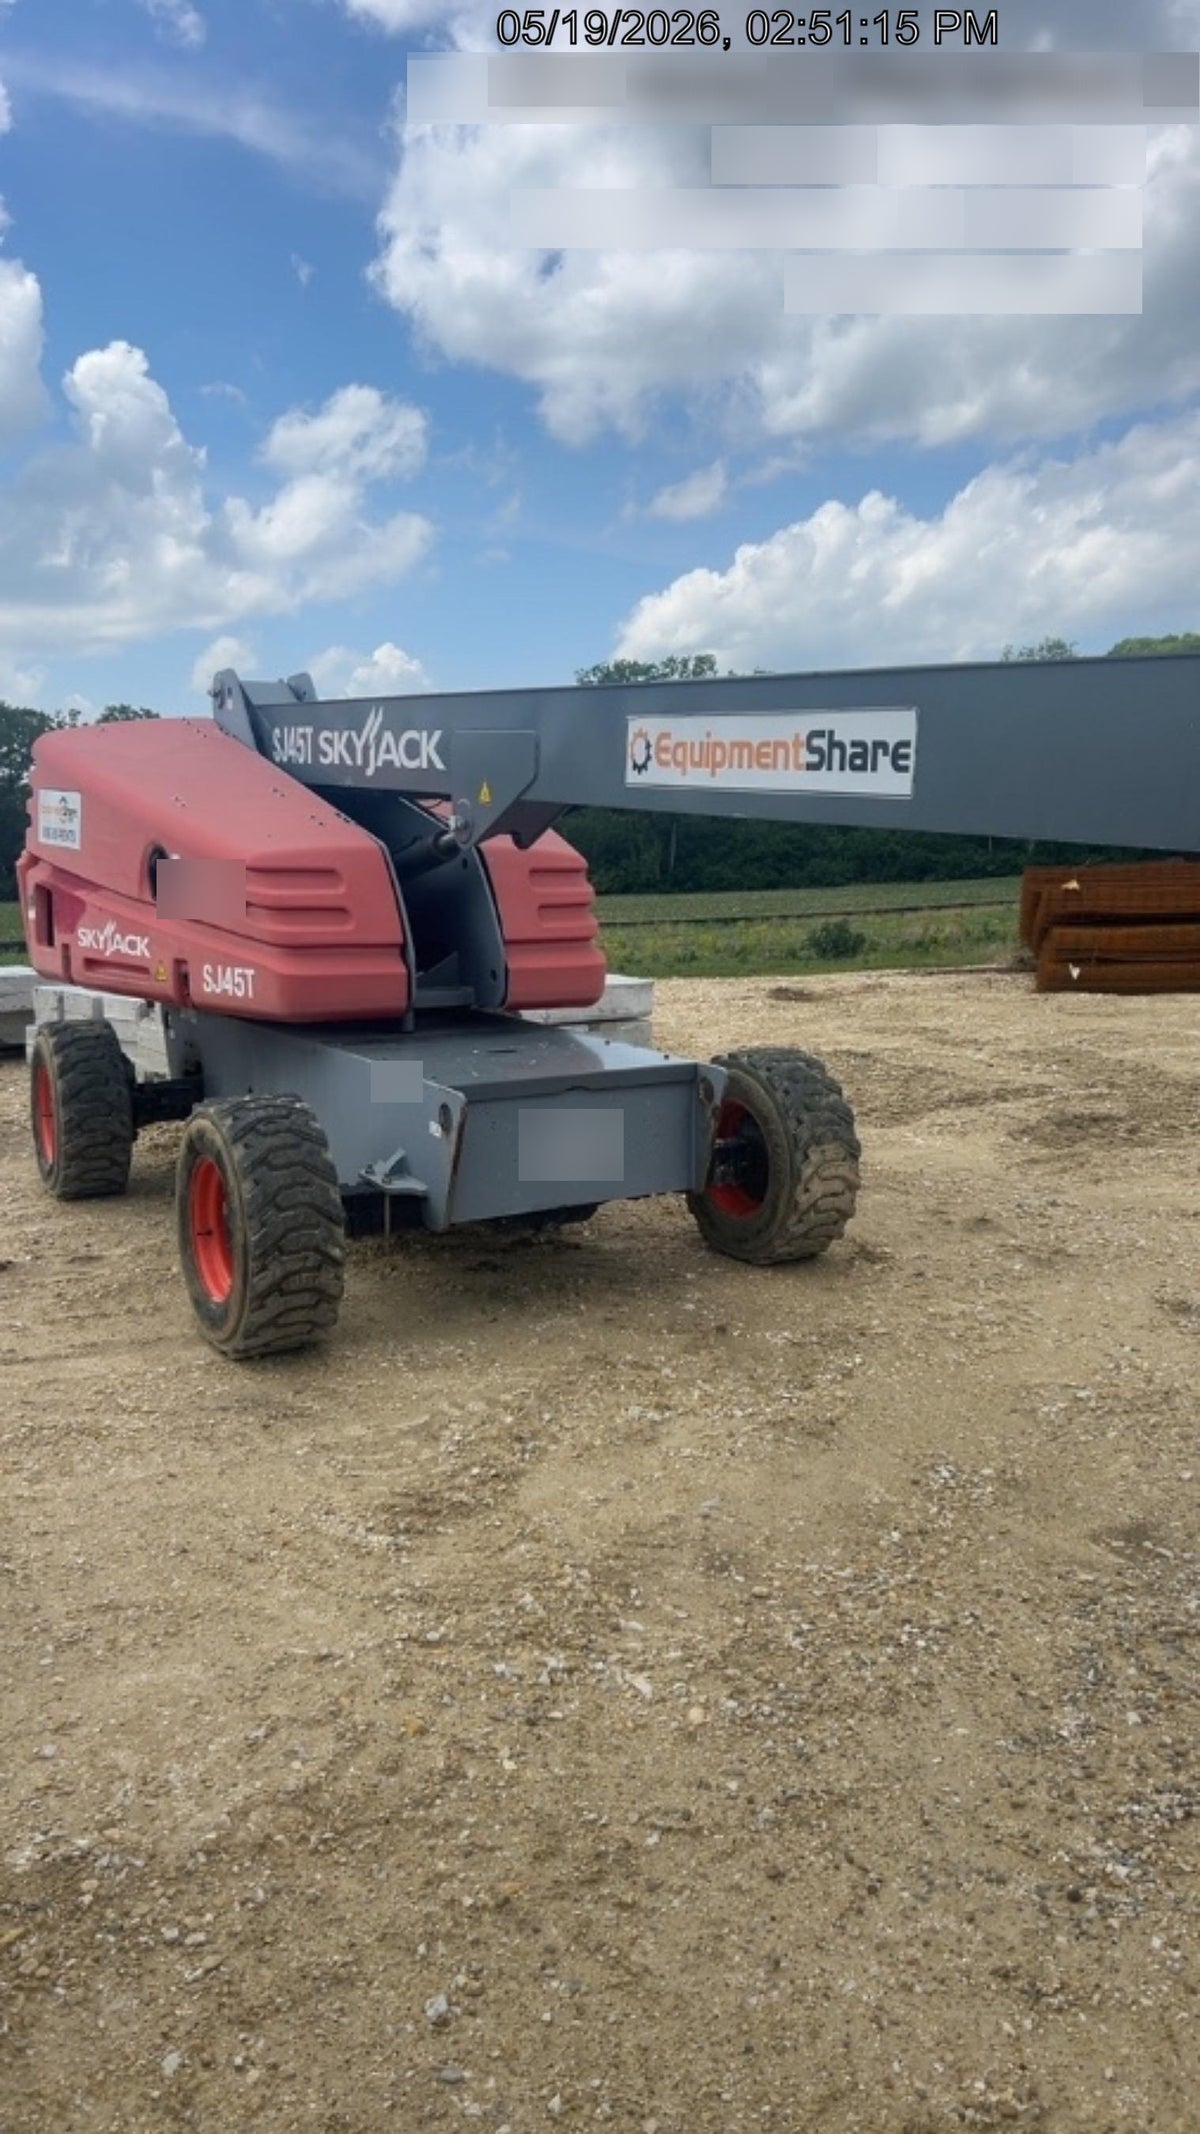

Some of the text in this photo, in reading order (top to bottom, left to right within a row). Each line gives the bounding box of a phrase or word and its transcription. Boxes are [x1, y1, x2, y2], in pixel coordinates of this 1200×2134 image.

[272, 706, 447, 777] SJ45T SKYJACK
[655, 729, 912, 778] EquipmentShare
[77, 919, 150, 958] SKYJACK
[203, 964, 255, 999] SJ45T
